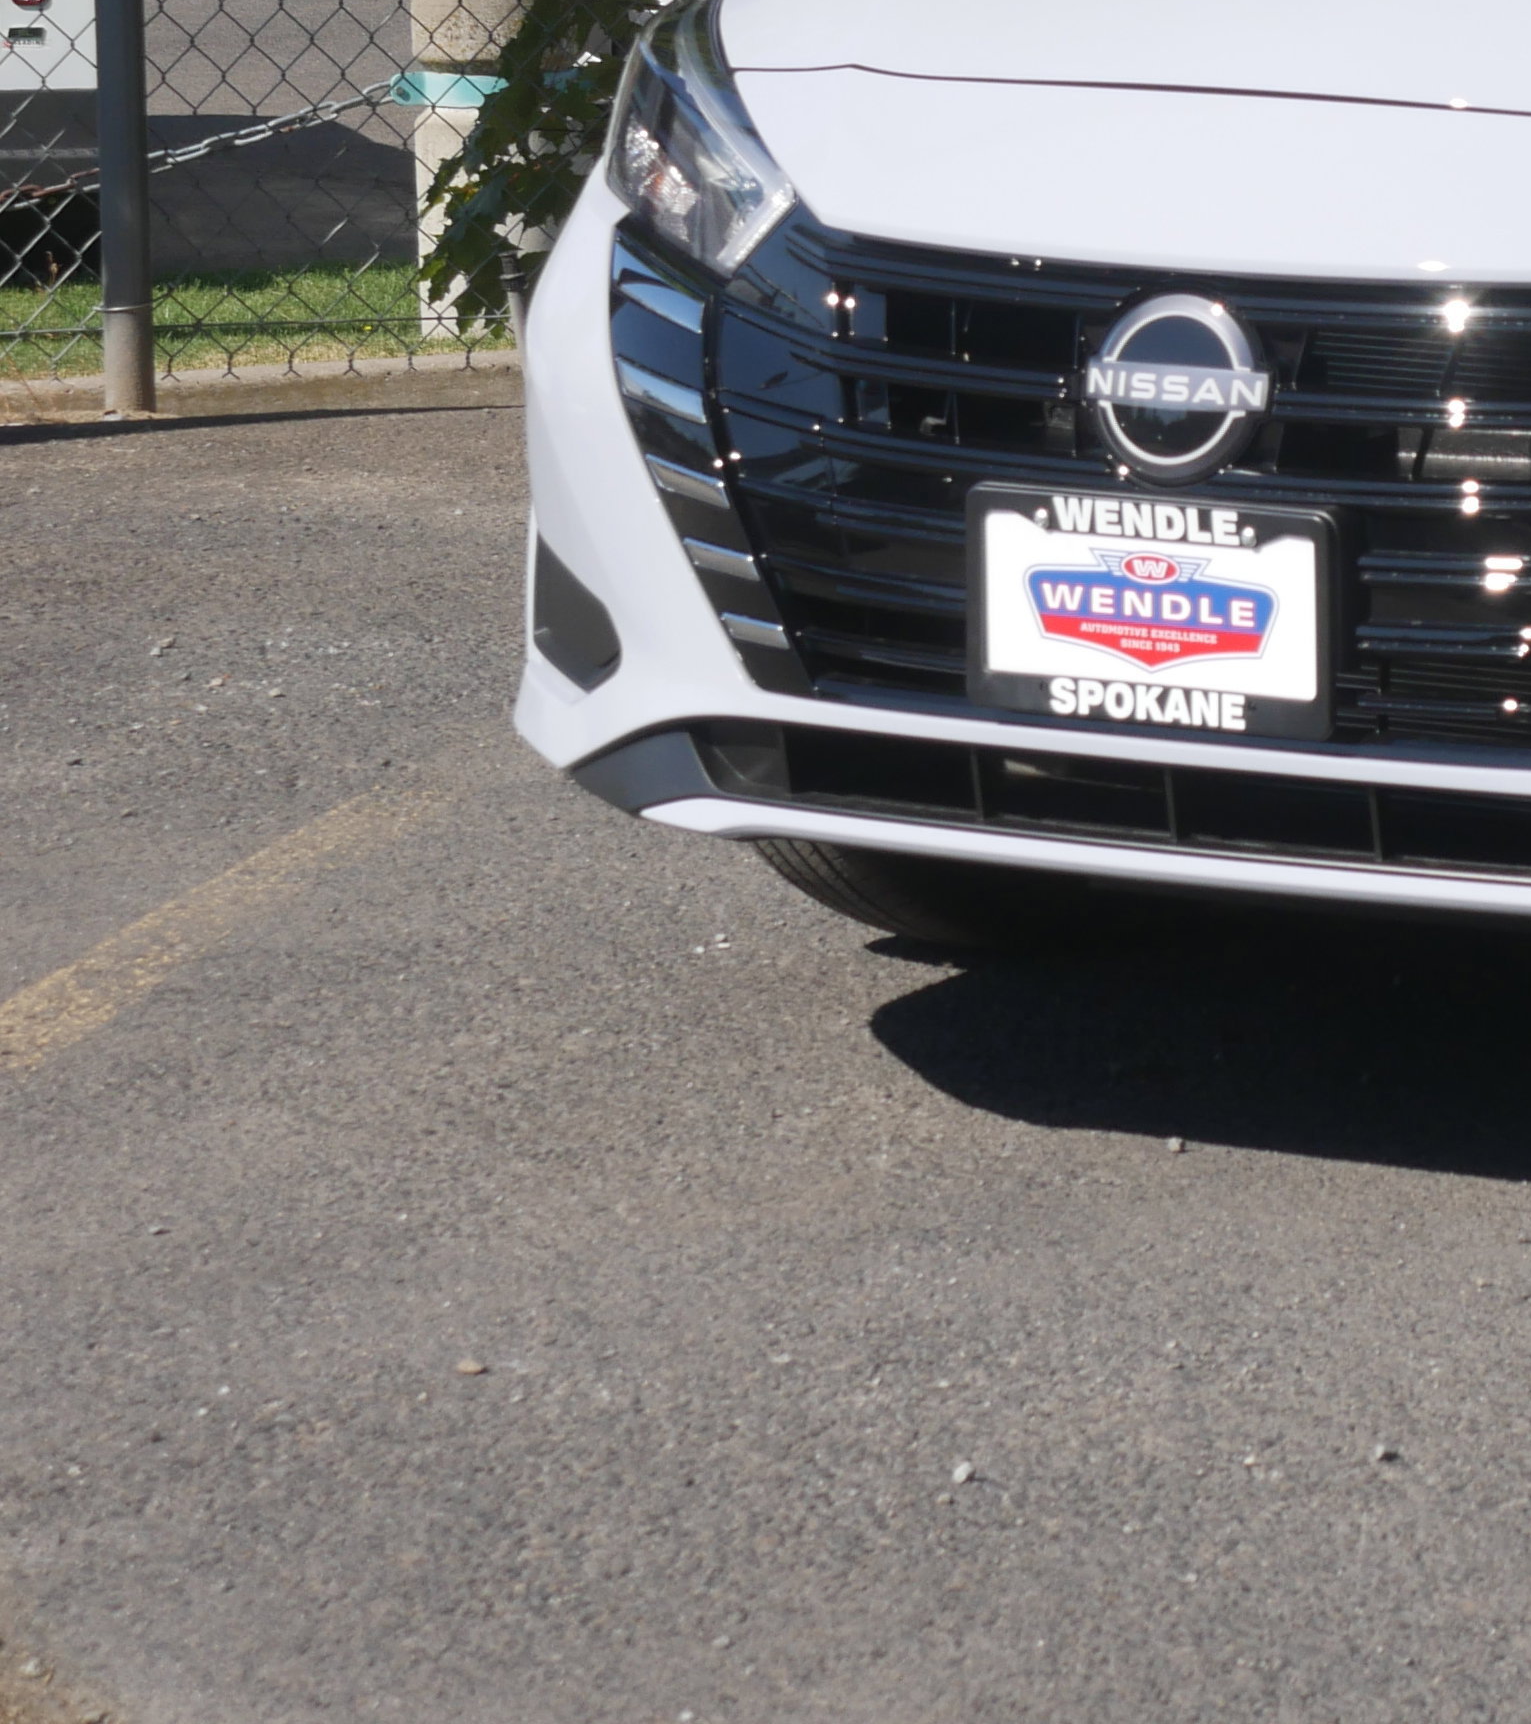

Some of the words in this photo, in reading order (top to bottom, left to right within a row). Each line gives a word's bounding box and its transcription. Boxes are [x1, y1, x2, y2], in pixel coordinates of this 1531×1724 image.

[1086, 366, 1265, 408] NISSAN
[1052, 495, 1241, 546] WENDLE
[1041, 582, 1256, 628] WENDLE
[1080, 622, 1149, 638] AUTOMOTIVE
[1150, 628, 1218, 645] EXCELLENCE
[1120, 638, 1153, 651] SINCE
[1049, 676, 1247, 731] SPOKANE
